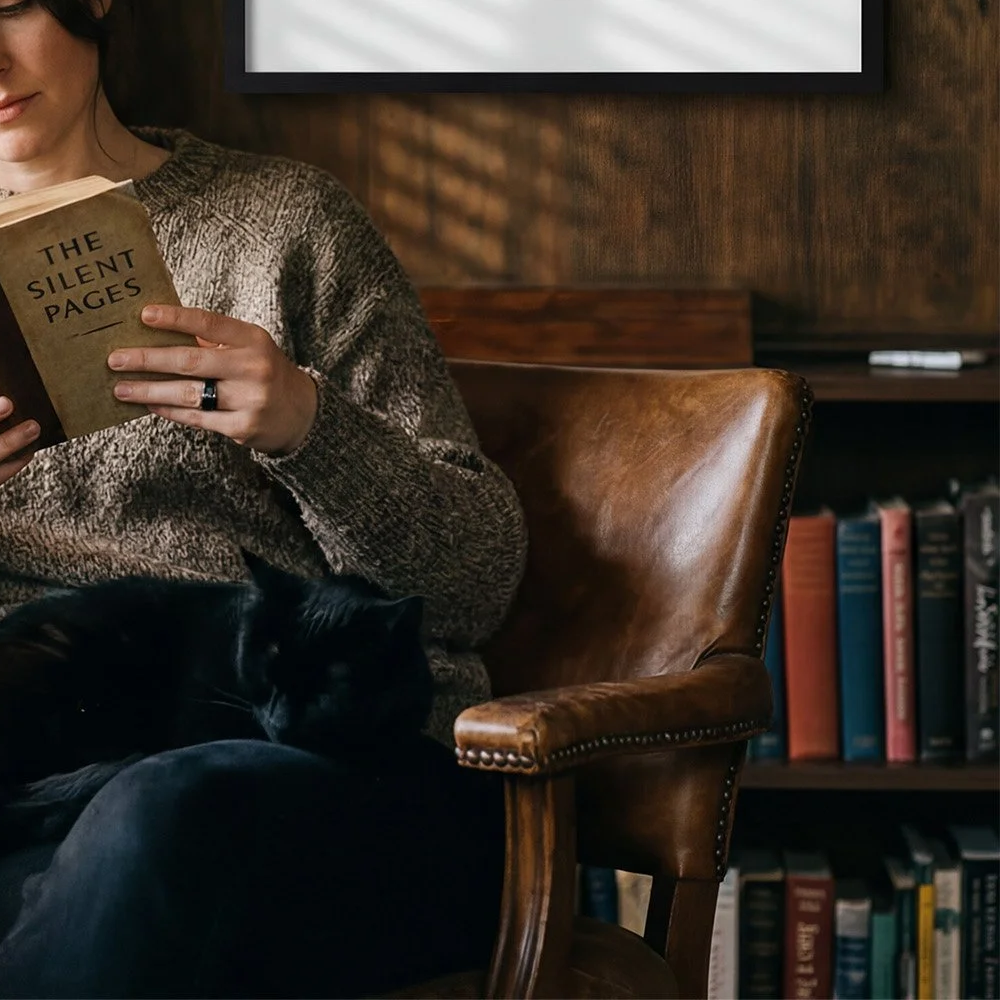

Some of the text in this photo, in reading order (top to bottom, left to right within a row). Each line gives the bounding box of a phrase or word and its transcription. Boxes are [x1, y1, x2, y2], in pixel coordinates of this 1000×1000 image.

[37, 230, 104, 265] THE
[26, 248, 135, 299] SILENT
[44, 277, 142, 323] PAGES
